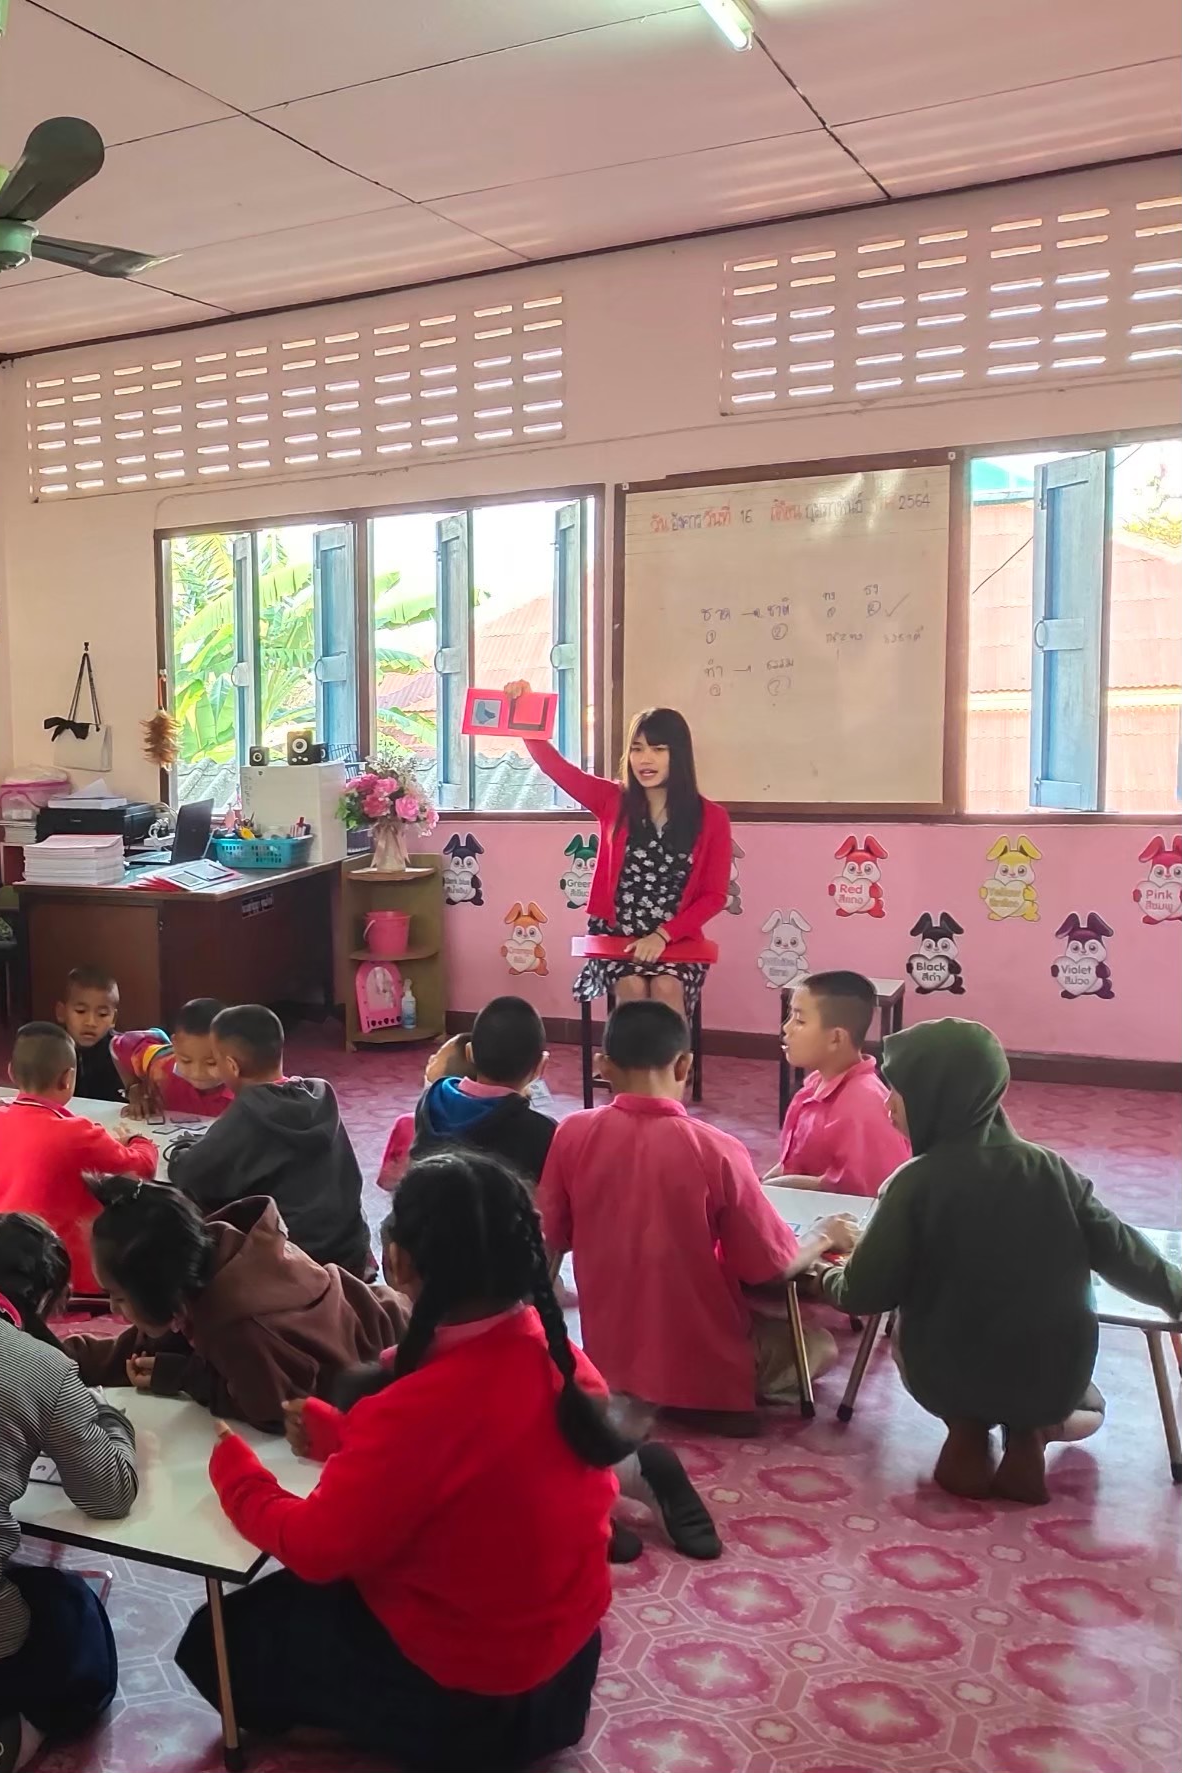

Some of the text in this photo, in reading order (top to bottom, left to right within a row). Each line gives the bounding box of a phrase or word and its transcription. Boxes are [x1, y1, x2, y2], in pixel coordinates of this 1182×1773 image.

[740, 509, 753, 524] 16
[840, 884, 863, 894] Red
[1146, 889, 1173, 899] Pink
[916, 962, 946, 971] Black
[1061, 965, 1092, 974] Violet
[922, 972, 942, 981] สีดำ
